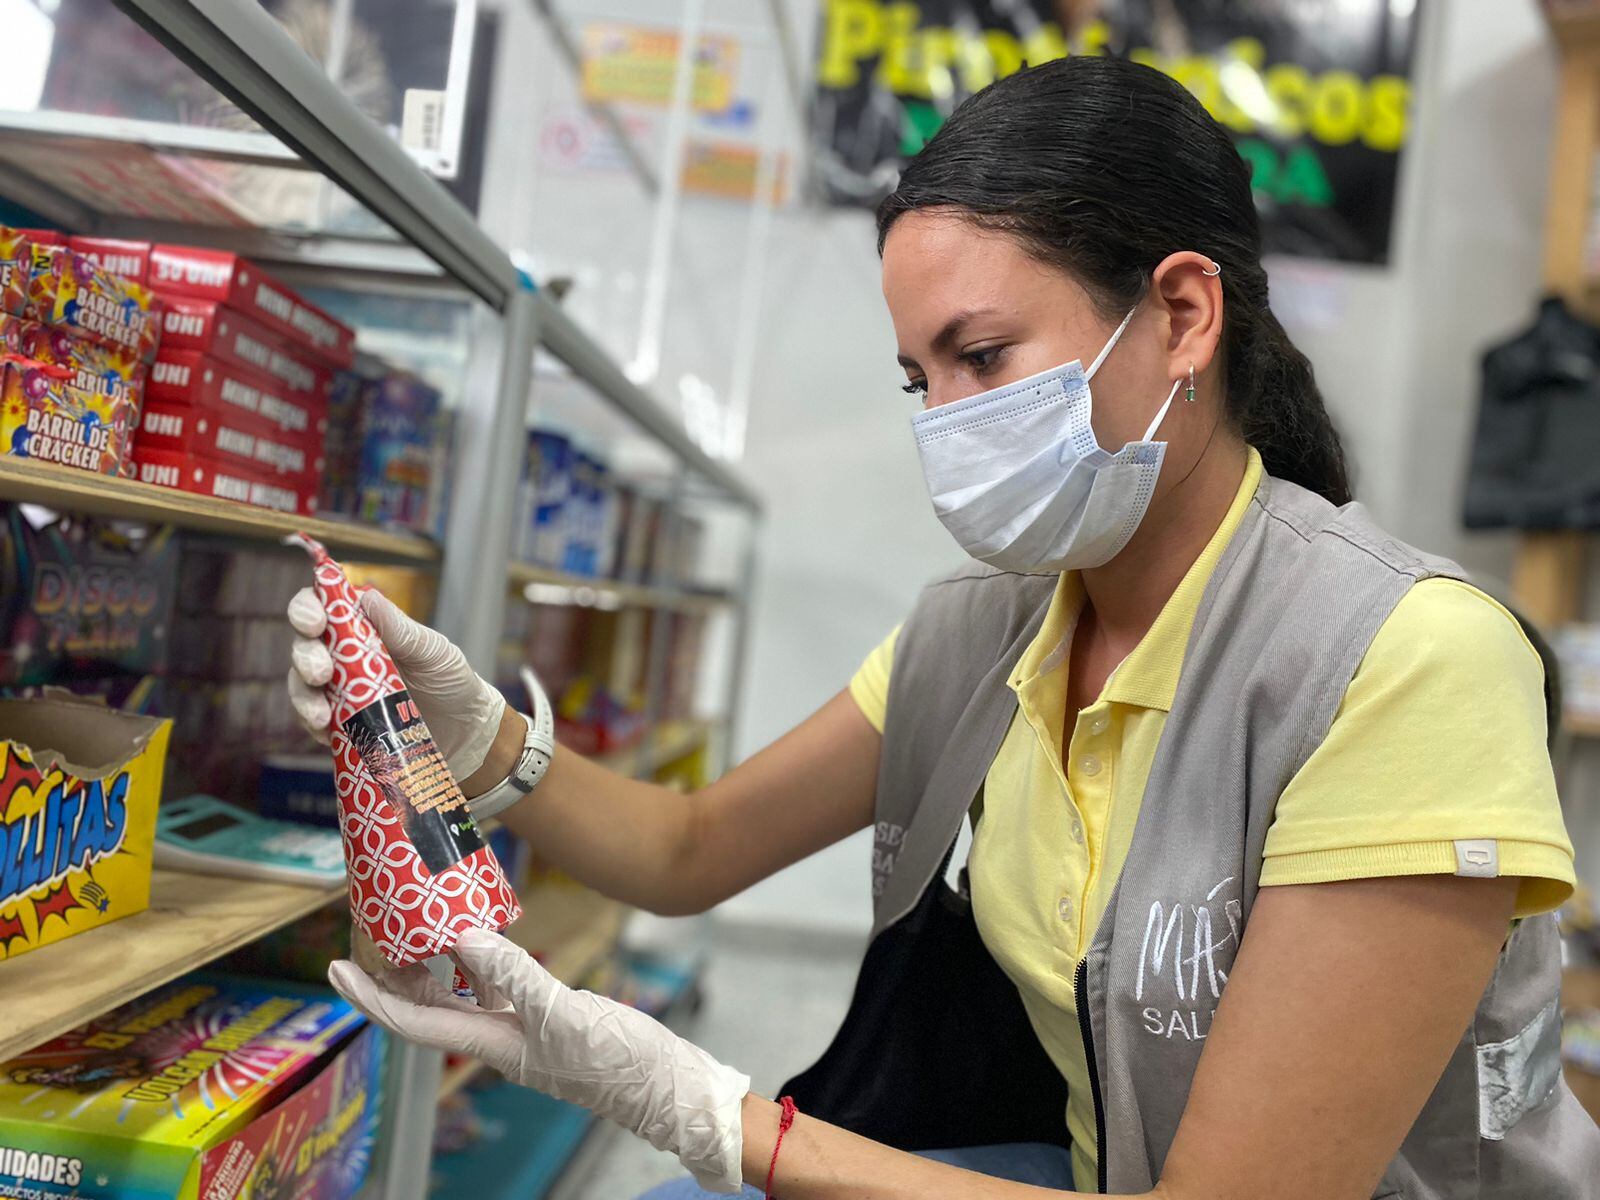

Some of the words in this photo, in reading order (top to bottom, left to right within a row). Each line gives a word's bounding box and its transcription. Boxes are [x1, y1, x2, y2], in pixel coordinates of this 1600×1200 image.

[76, 286, 128, 326] BARRIL
[129, 311, 146, 334] DE
[78, 307, 140, 348] CRACKER
[164, 312, 205, 337] UNI
[151, 362, 191, 387] UNI
[27, 408, 86, 445] BARRIL
[88, 426, 109, 452] DE
[144, 411, 184, 437] UNI
[28, 433, 100, 471] CRACKER
[141, 463, 180, 488] UNI
[1142, 1006, 1216, 1042] SAL
